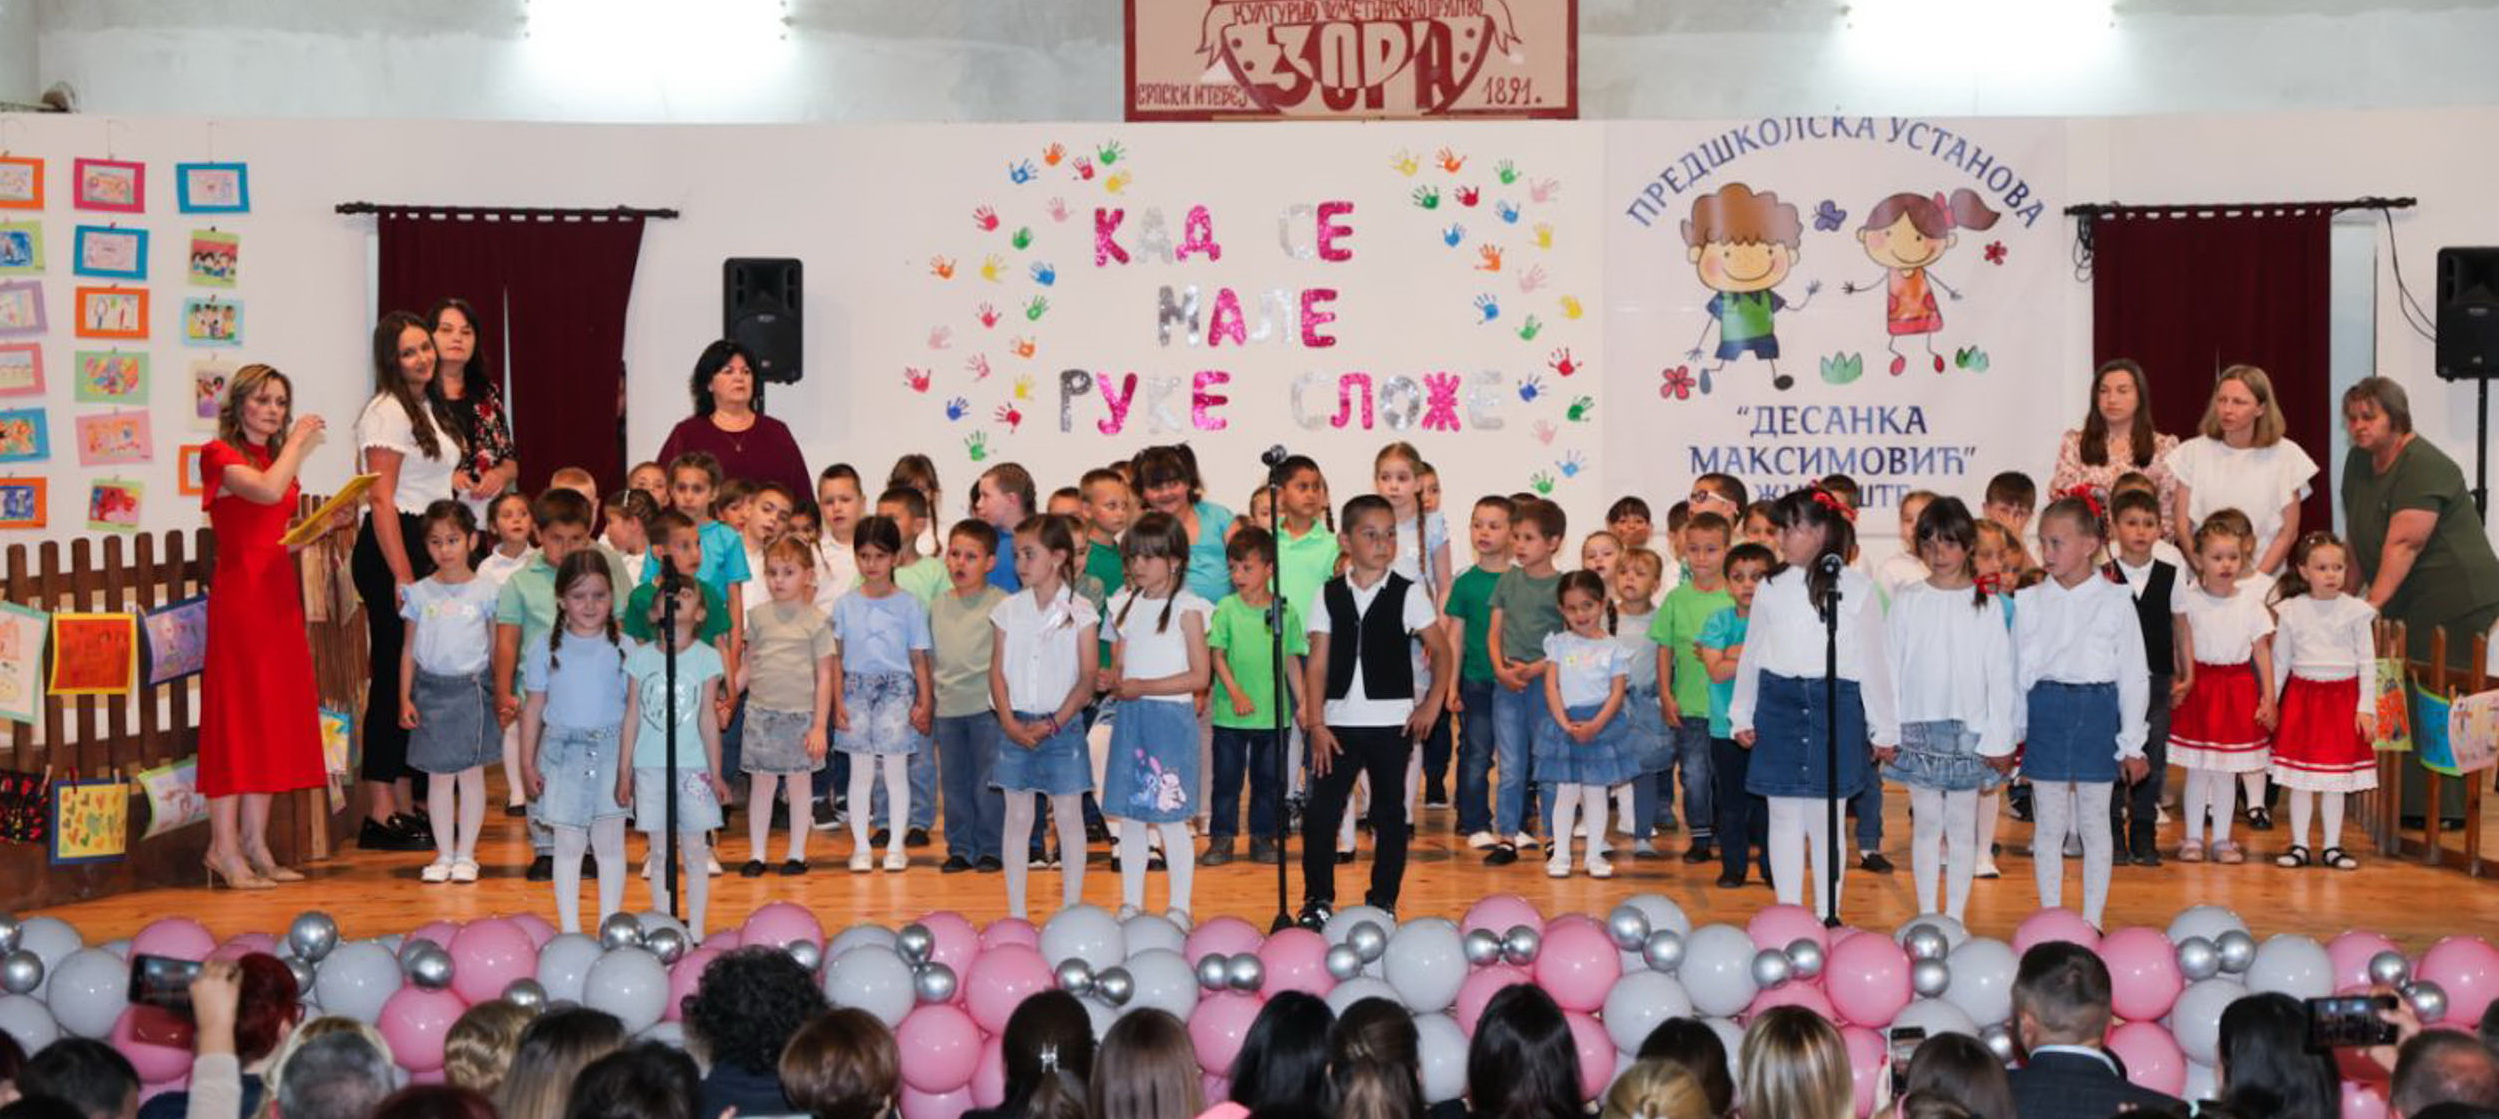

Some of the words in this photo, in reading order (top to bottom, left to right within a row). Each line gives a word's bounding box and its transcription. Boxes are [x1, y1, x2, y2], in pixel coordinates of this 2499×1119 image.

[1137, 83, 1191, 106] СРПСКИ
[1256, 20, 1456, 112] ЗОРА
[1482, 76, 1542, 105] 1891.
[1625, 116, 1876, 228] ПРЕДШКОЛСКА
[1887, 116, 2046, 229] УСТАНОВА
[1094, 204, 1222, 267] КАД
[1279, 201, 1354, 263] СЕ
[1157, 284, 1338, 348] МАЛЕ
[1059, 368, 1231, 435] РУКЕ
[1289, 369, 1505, 432] СЛОЖЕ
